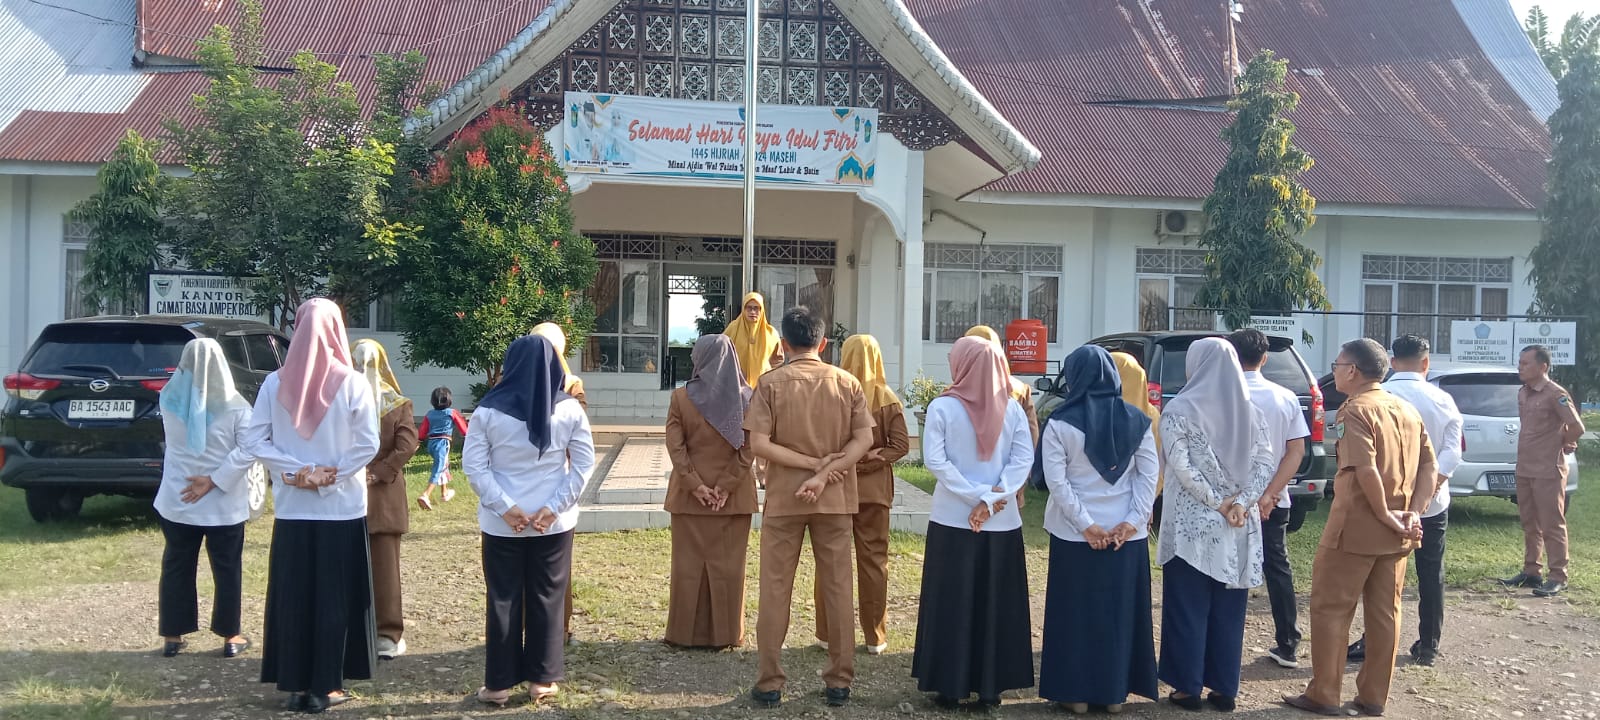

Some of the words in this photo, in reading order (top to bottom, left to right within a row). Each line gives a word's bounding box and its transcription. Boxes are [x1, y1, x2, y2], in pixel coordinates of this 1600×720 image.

[628, 119, 692, 144] Selamat
[696, 122, 733, 145] Hari
[786, 127, 819, 151] Idul
[823, 129, 858, 151] Fitri
[691, 147, 709, 160] 1445
[711, 147, 740, 161] HIJRIAH
[769, 151, 797, 164] MASEHI
[182, 291, 244, 301] KANTOR
[156, 301, 184, 314] CAMAT
[186, 302, 207, 315] BASA
[208, 302, 238, 316] AMPEK
[71, 402, 83, 412] BA
[86, 402, 110, 412] 1543
[113, 402, 131, 412] AAC
